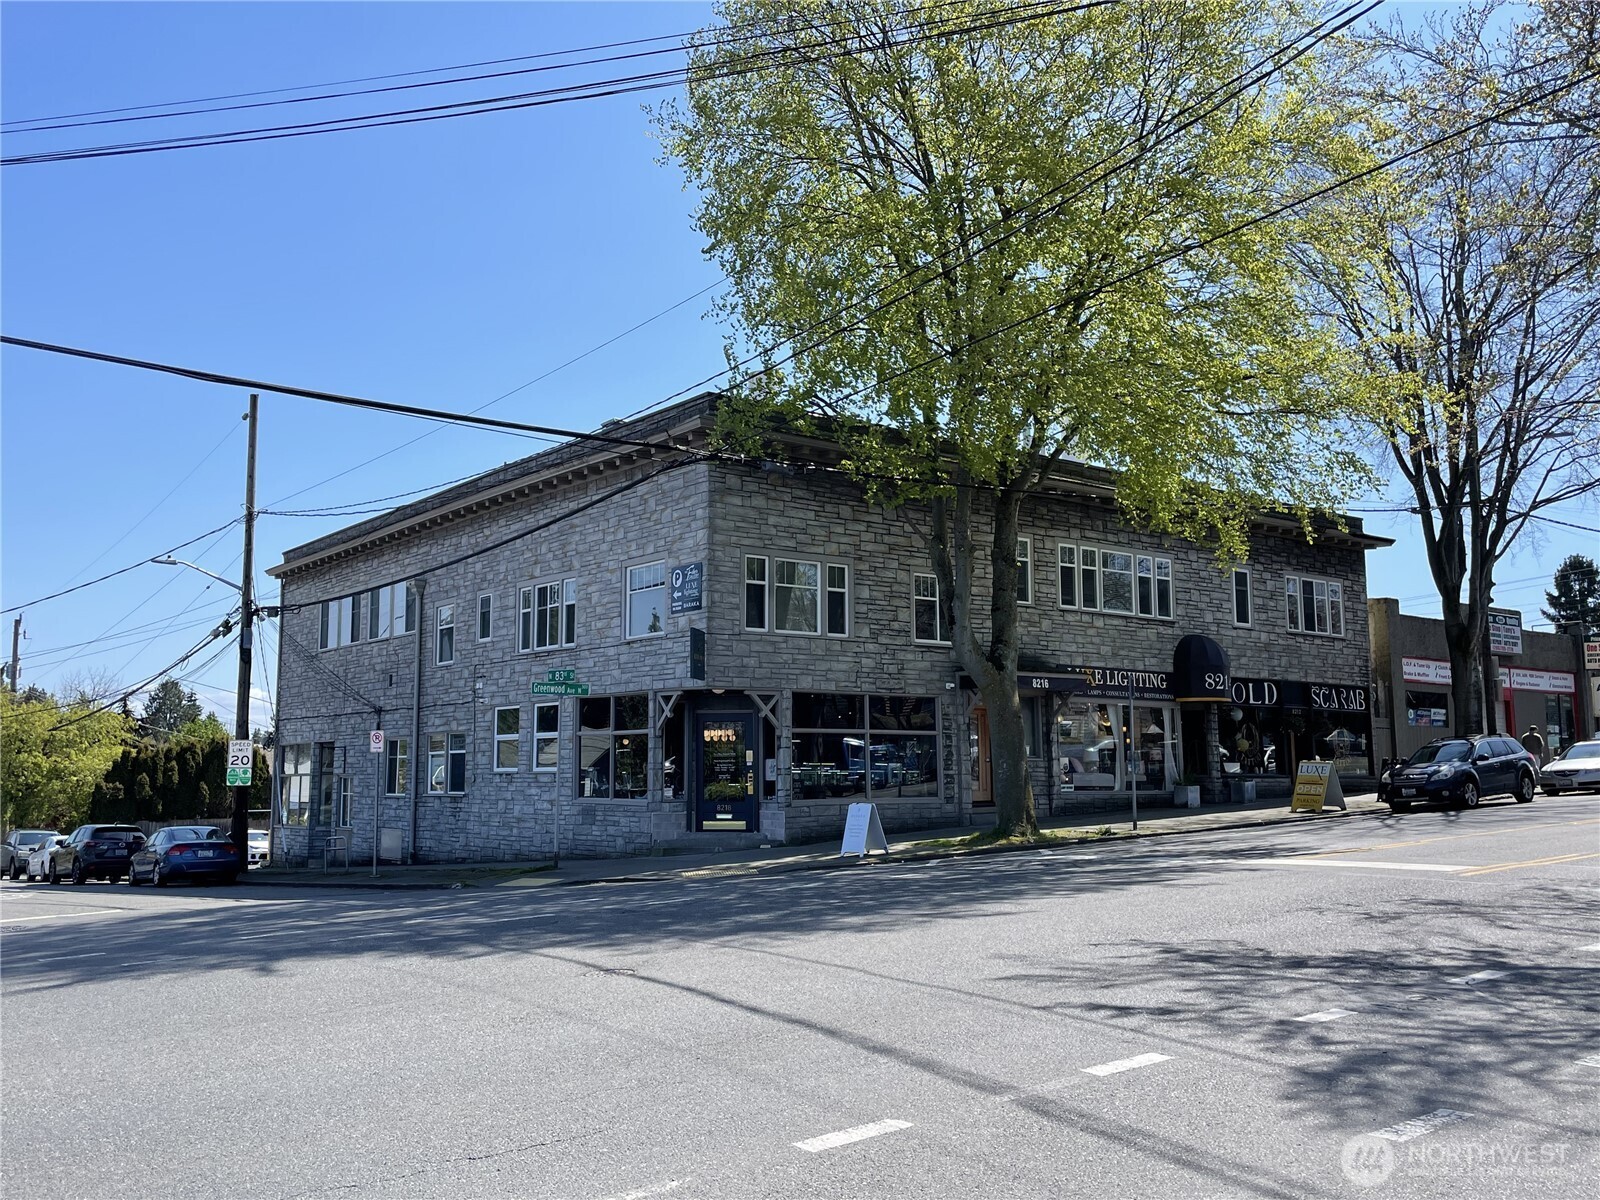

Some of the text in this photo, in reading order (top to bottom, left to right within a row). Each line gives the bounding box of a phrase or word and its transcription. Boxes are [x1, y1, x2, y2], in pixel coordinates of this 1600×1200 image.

[683, 601, 700, 609] BARAKA
[1587, 644, 1598, 653] One
[533, 683, 566, 694] Greenwood
[1032, 678, 1049, 689] 8216
[1144, 692, 1174, 700] RESTORATIONS
[1232, 682, 1277, 705] OLD
[1311, 685, 1366, 710] SCARAB
[230, 755, 250, 766] 20
[1300, 765, 1327, 779] LUXE
[1297, 785, 1323, 794] OPEN
